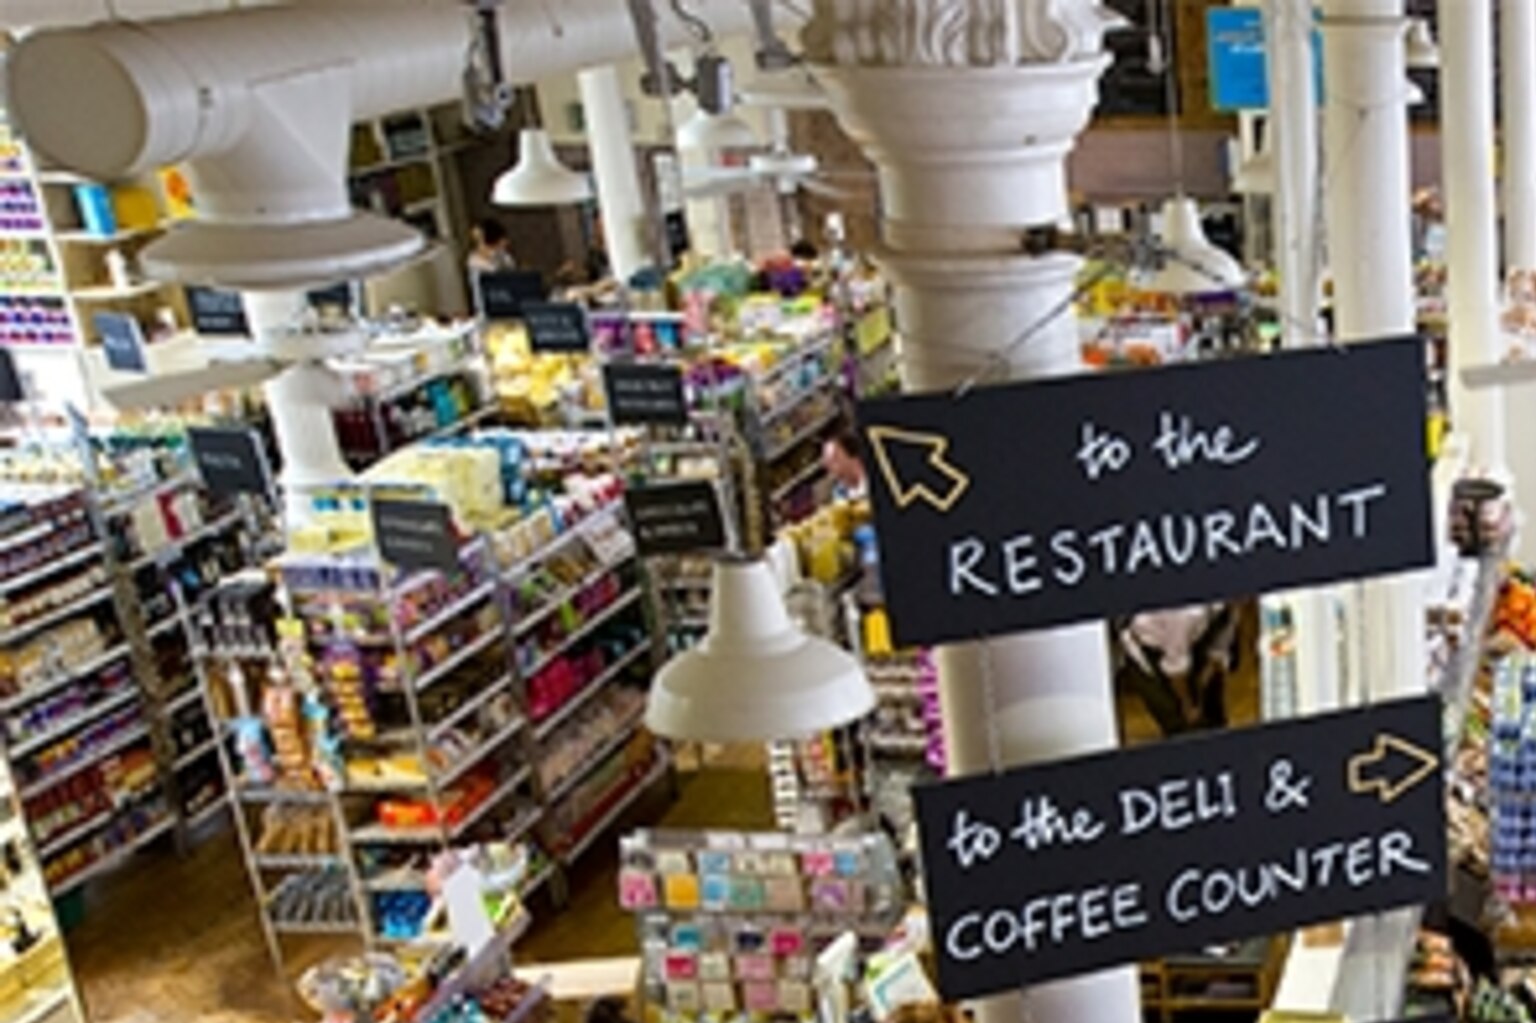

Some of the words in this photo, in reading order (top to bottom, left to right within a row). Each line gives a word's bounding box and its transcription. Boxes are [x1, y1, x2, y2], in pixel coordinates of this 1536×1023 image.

[1076, 425, 1131, 479] to
[1153, 412, 1258, 469] the
[948, 484, 1386, 597] RESTAURANT
[947, 810, 1002, 868] to
[1010, 795, 1106, 850] the
[1119, 772, 1237, 835] DELI
[1264, 759, 1310, 811] &
[945, 883, 1148, 961] COFFEE
[1167, 830, 1431, 921] COUNTER
